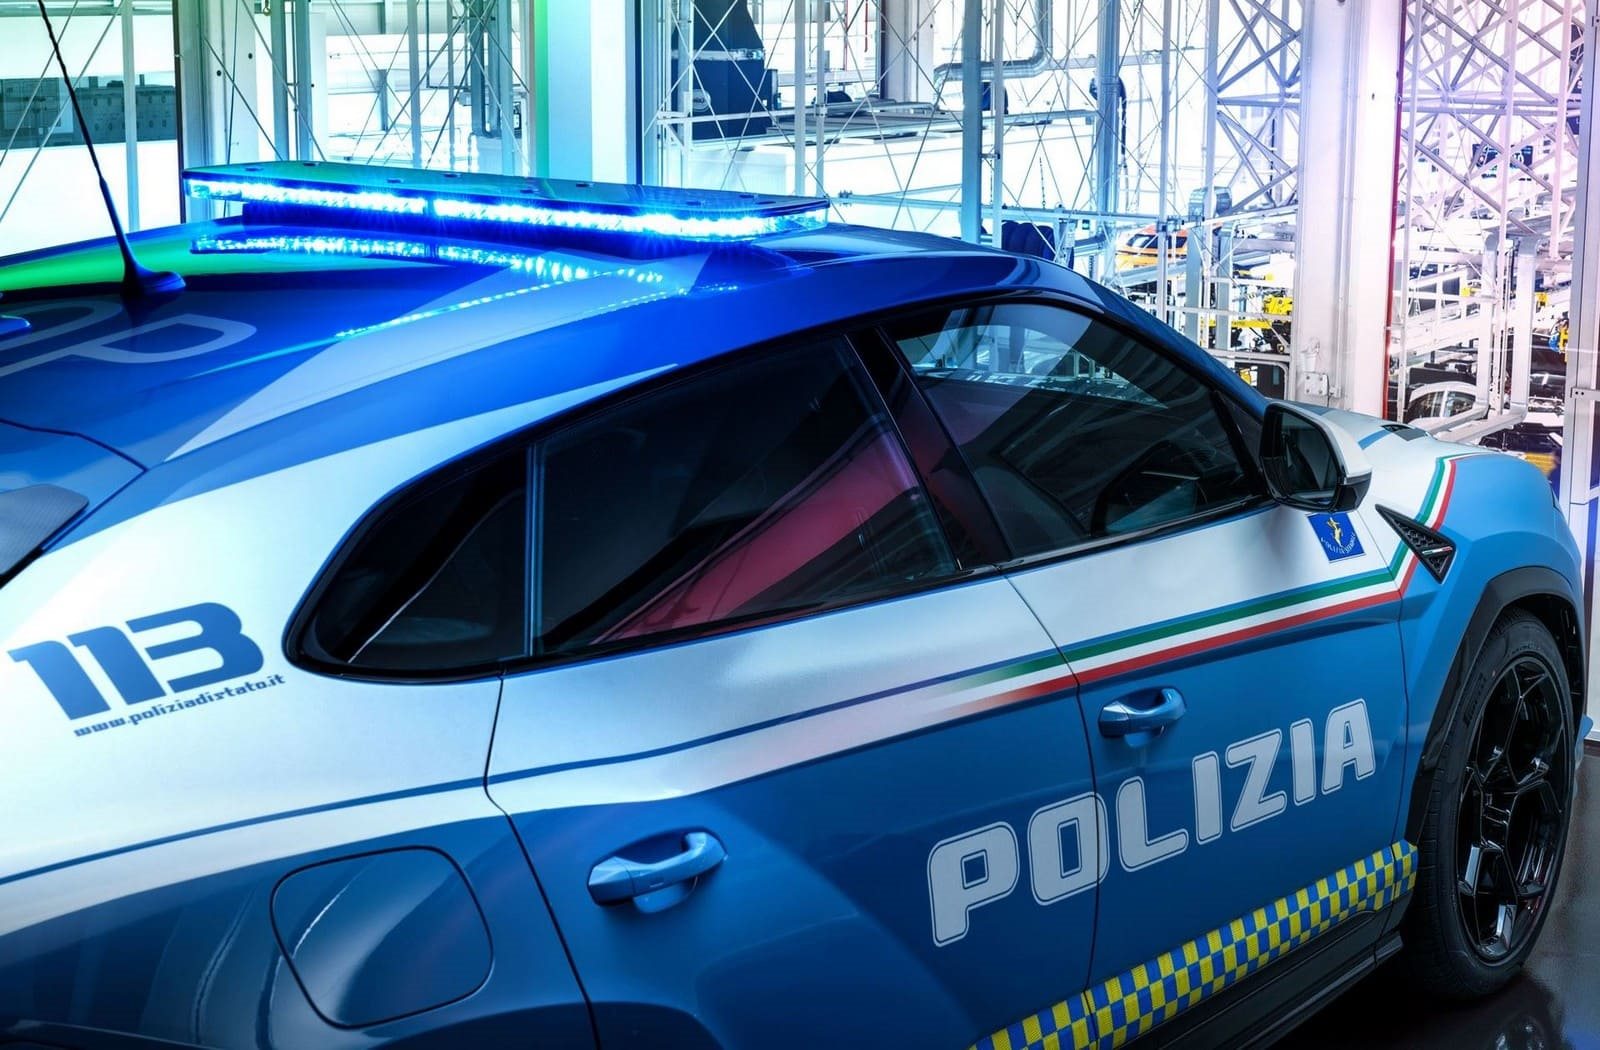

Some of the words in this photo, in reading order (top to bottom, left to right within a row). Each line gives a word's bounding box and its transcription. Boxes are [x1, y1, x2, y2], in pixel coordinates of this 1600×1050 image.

[7, 601, 264, 720] 113
[73, 673, 286, 737] www.poliziadistato.it
[927, 697, 1376, 948] POLIZIA
